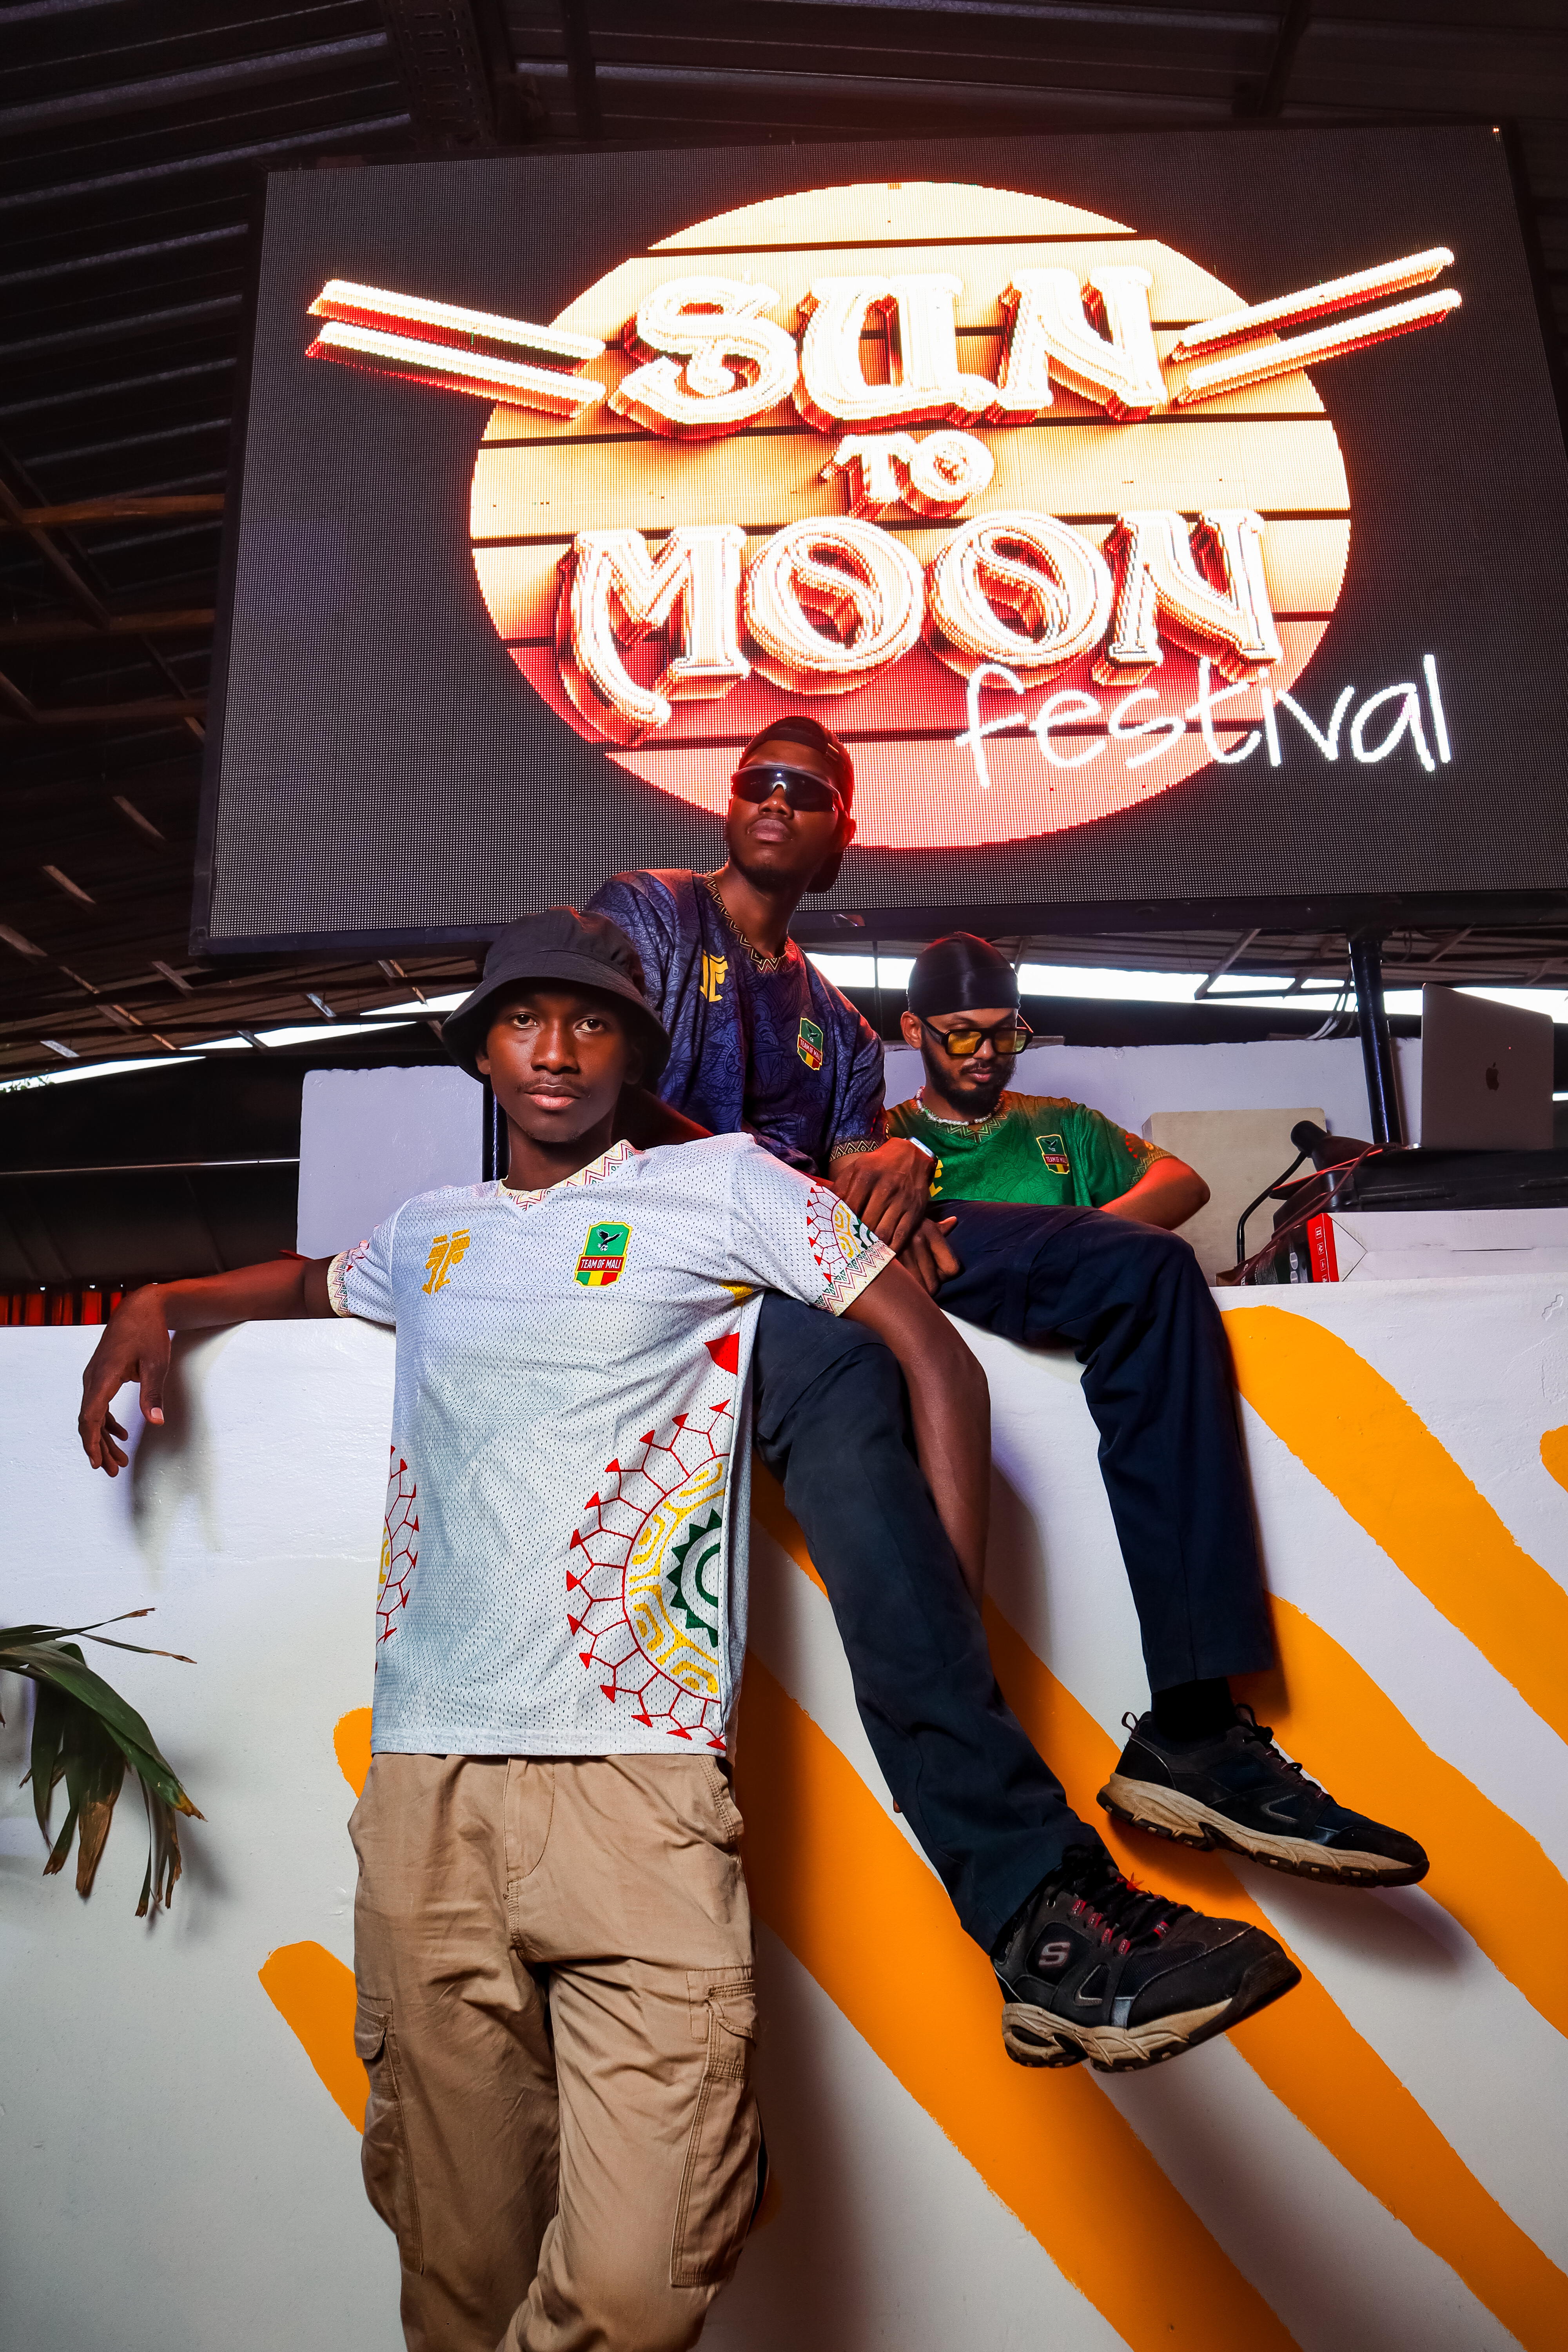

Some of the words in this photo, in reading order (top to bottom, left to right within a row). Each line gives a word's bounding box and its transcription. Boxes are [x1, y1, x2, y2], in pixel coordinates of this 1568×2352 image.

[821, 430, 995, 518] TO
[559, 510, 1280, 743] MOON
[956, 654, 1452, 789] festival
[800, 1039, 810, 1052] TEAM
[581, 1259, 598, 1269] TEAM
[597, 1259, 606, 1269] OF
[605, 1259, 622, 1269] MALI
[1038, 1941, 1071, 1968] S
